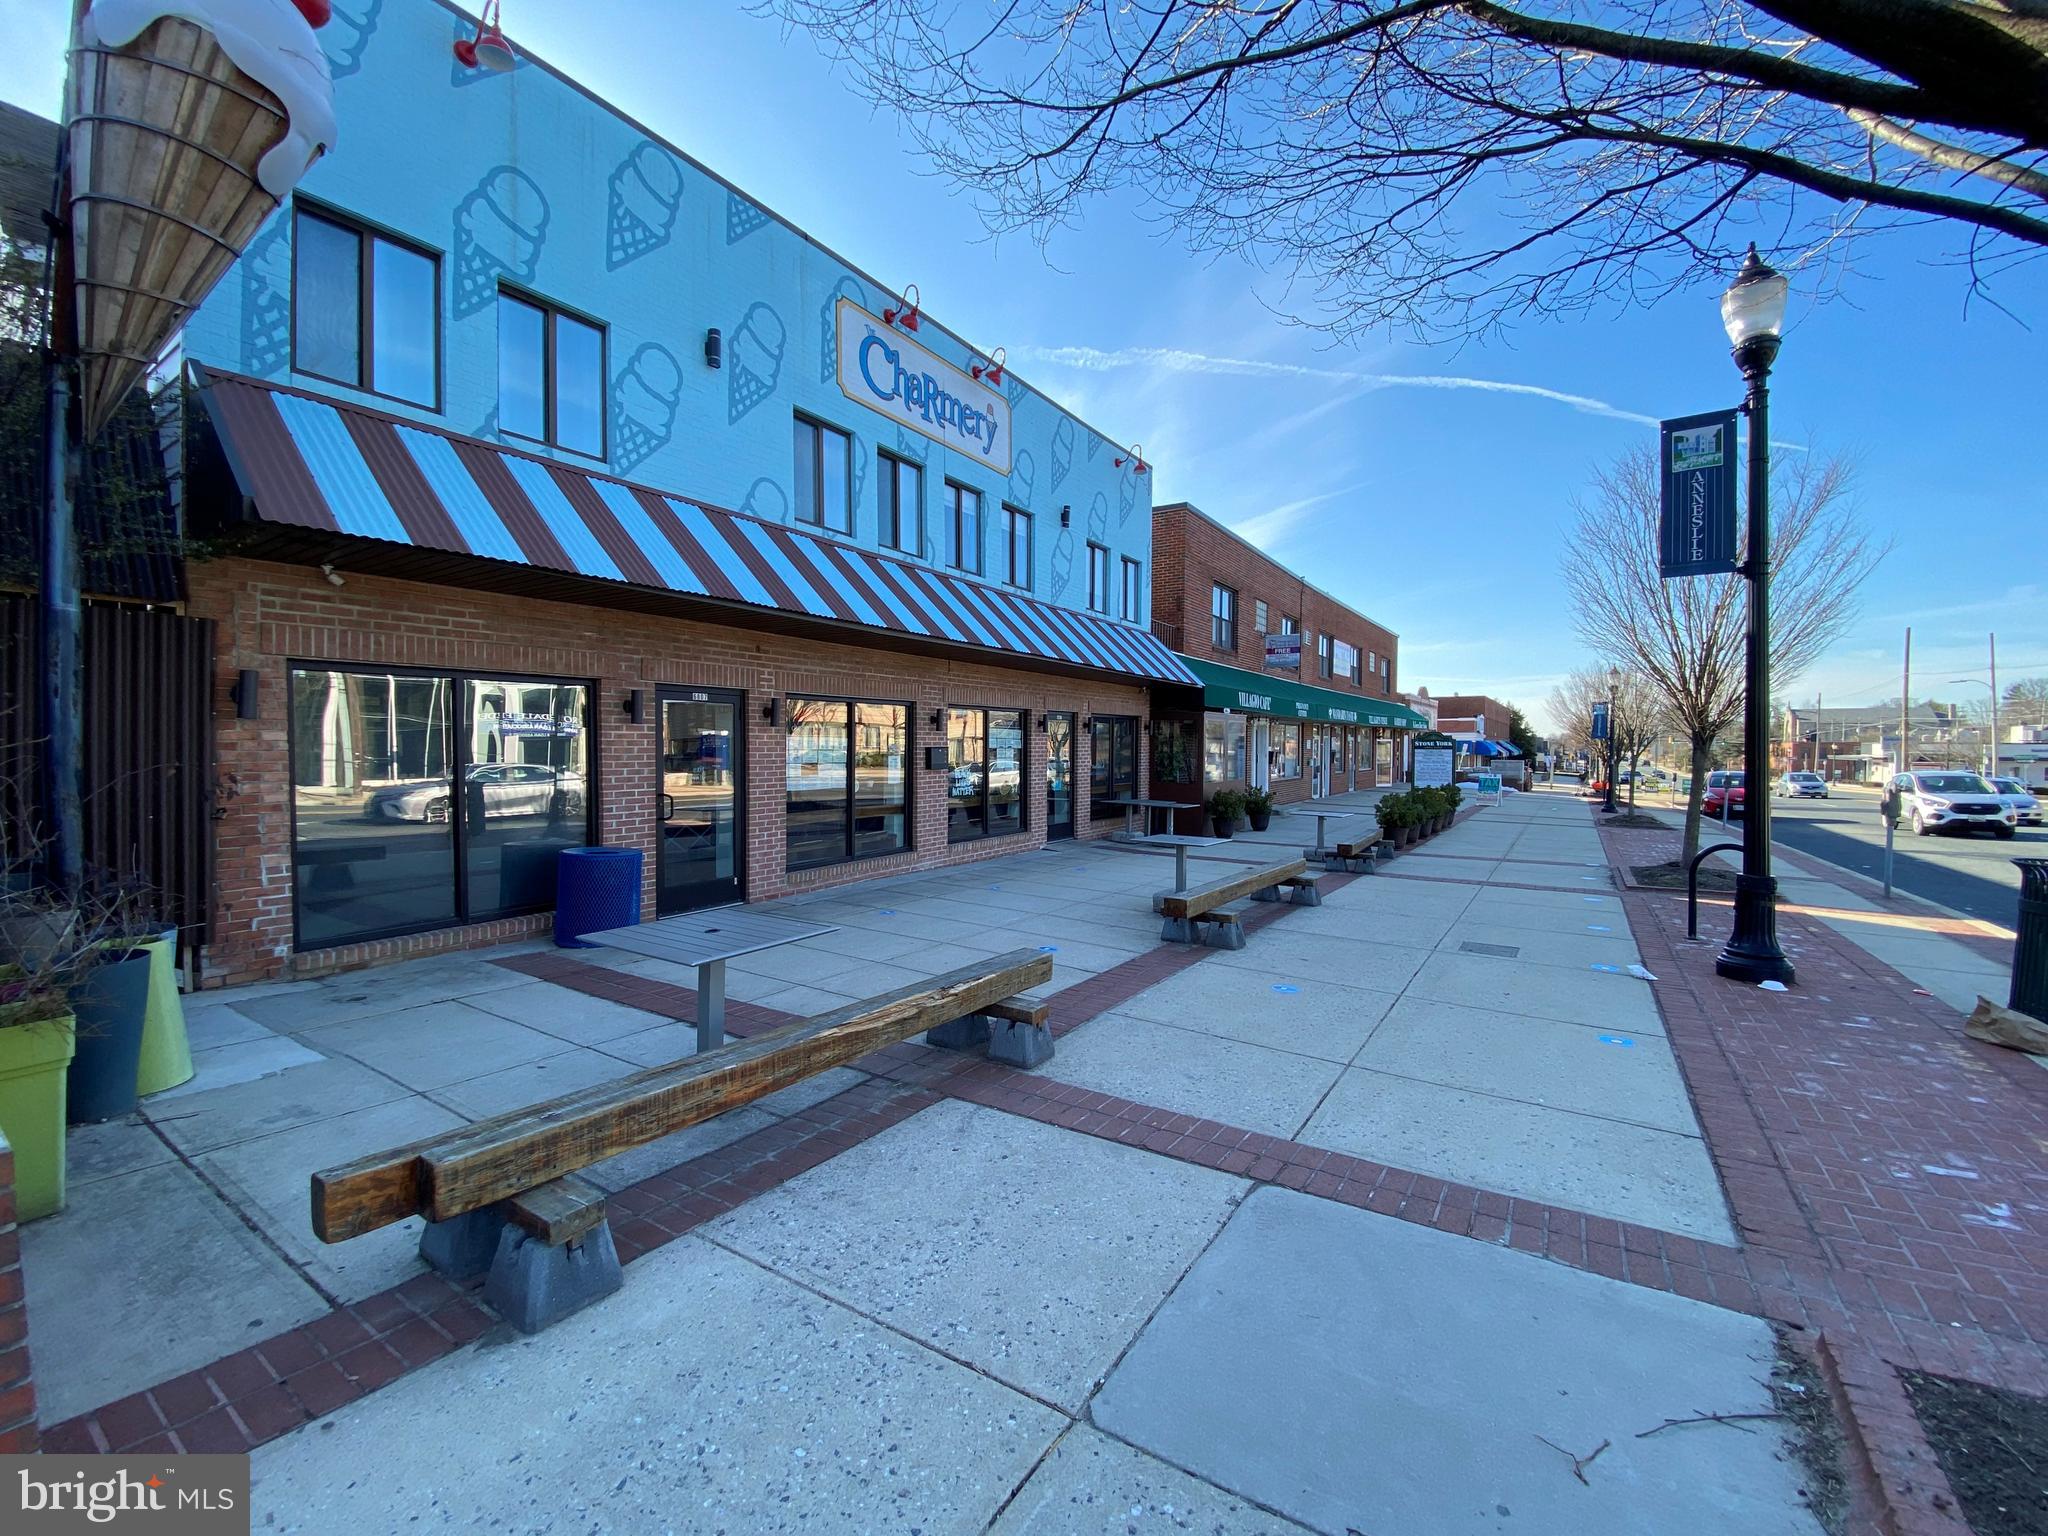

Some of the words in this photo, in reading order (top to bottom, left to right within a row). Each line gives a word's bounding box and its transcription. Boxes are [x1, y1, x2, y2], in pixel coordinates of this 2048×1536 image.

[1690, 471, 1705, 562] ANNESLIE
[1275, 647, 1291, 655] FREE
[1479, 777, 1499, 787] TAX
